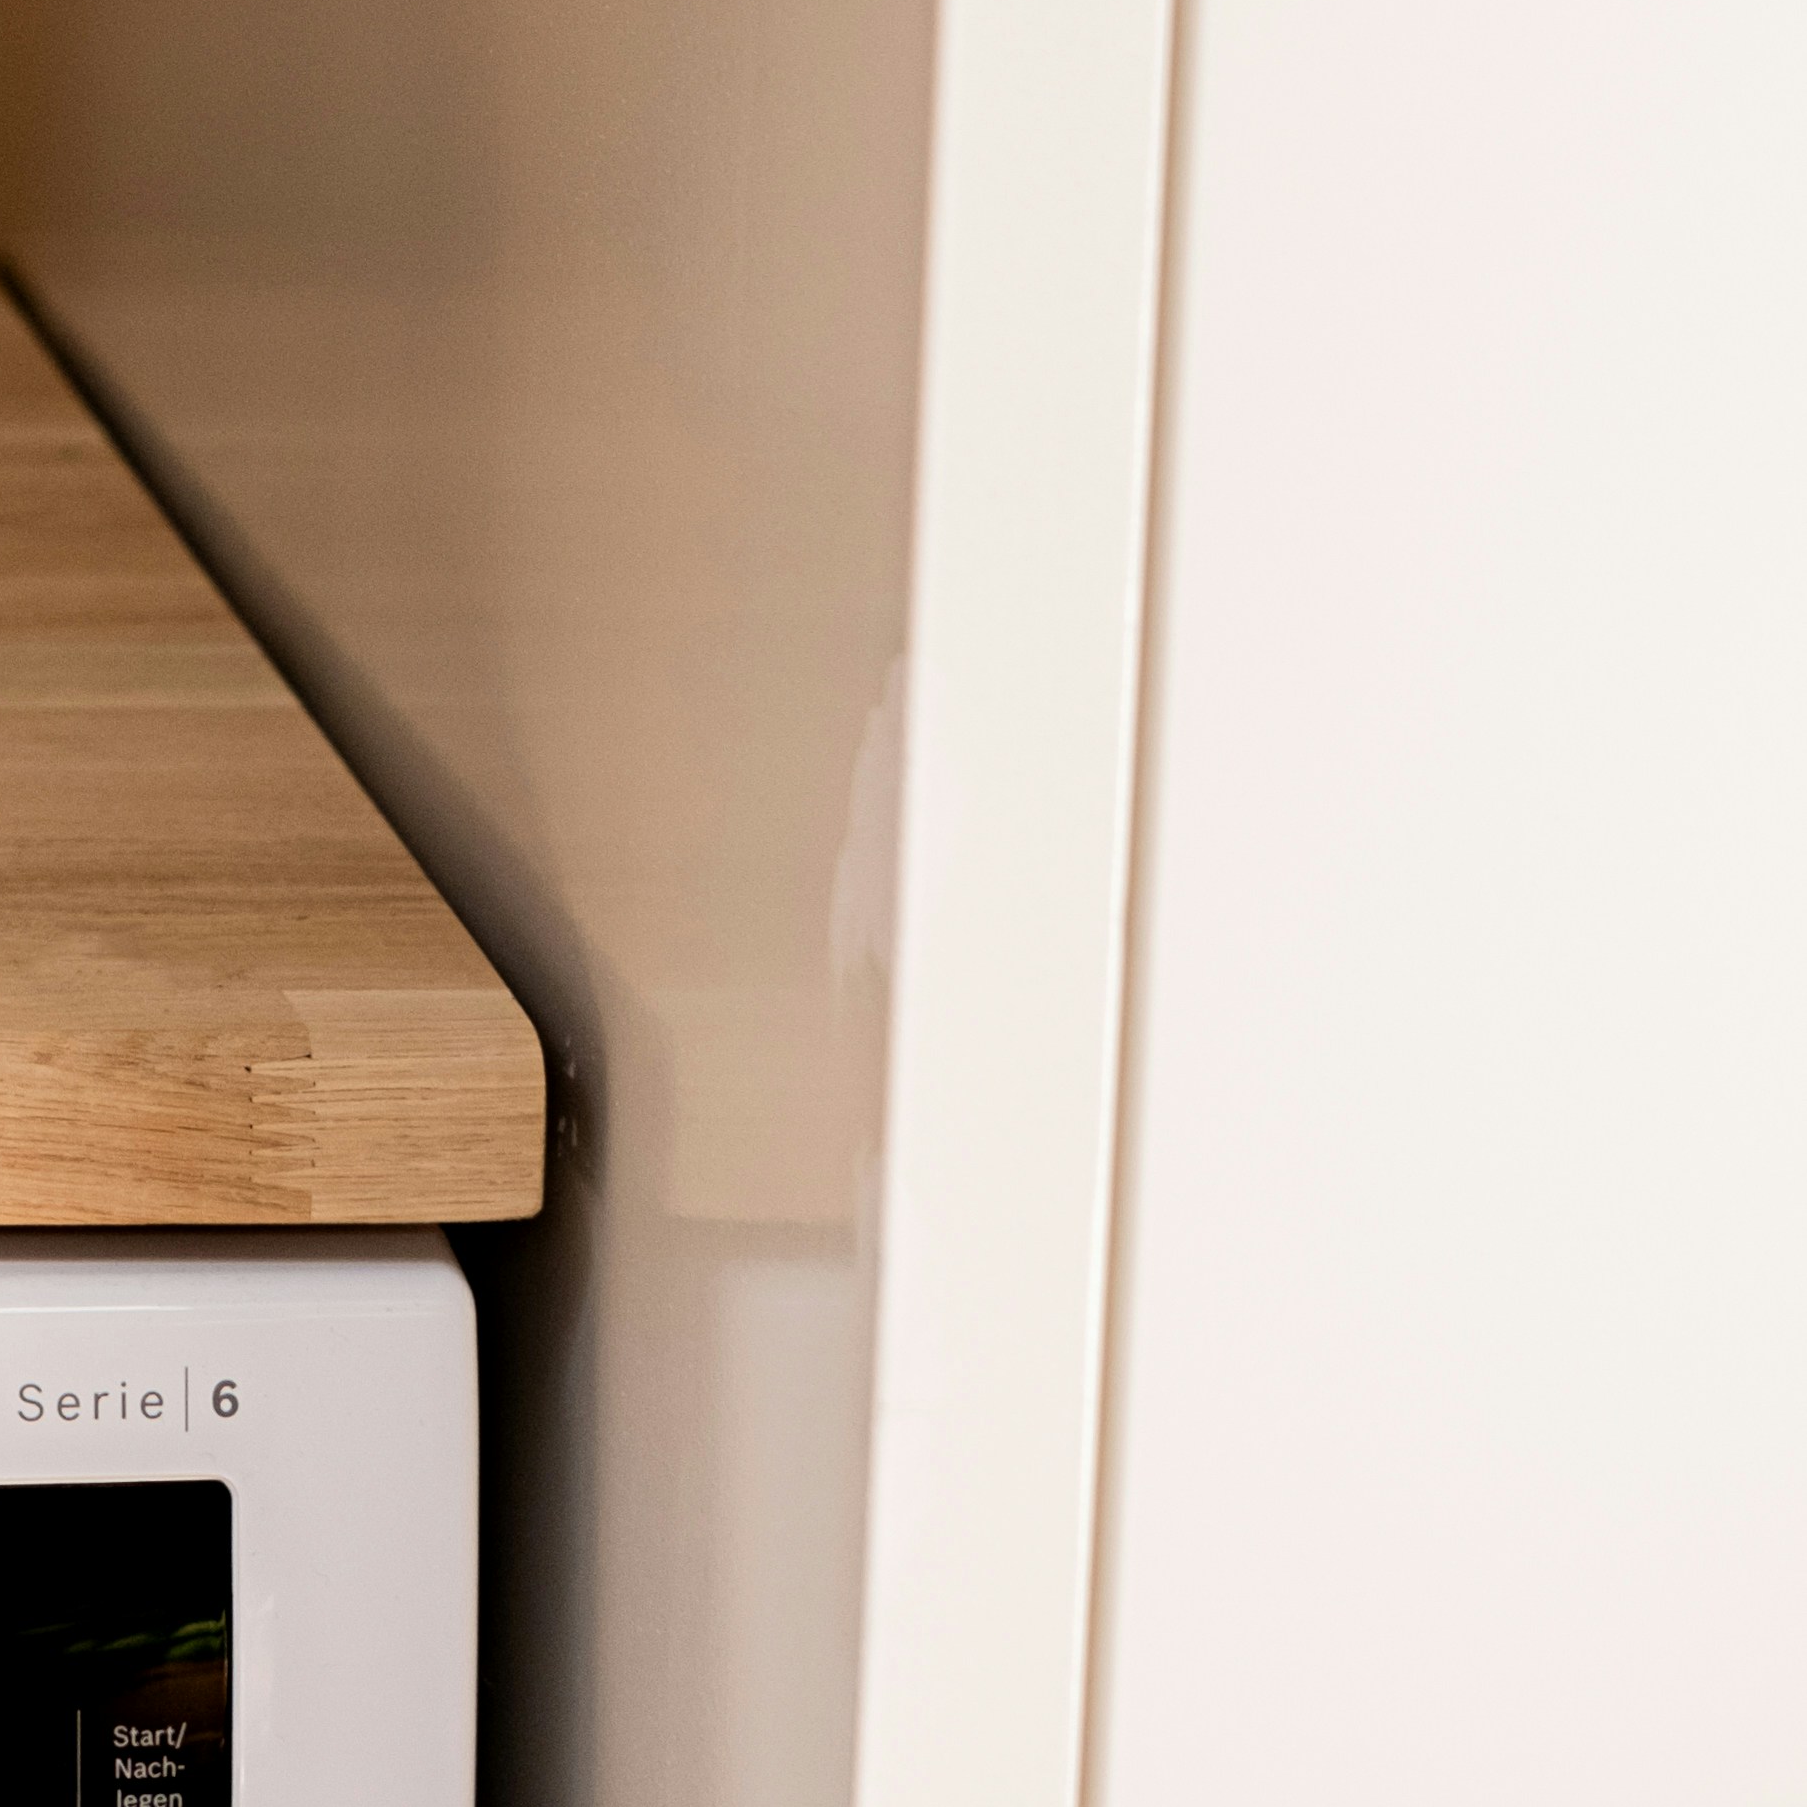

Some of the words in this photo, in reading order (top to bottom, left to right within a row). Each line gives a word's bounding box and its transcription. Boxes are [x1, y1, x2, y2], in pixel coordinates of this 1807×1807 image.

[17, 1381, 166, 1423] Serie
[211, 1379, 240, 1418] 6
[113, 1721, 187, 1750] Start/
[114, 1755, 186, 1780] Nach-
